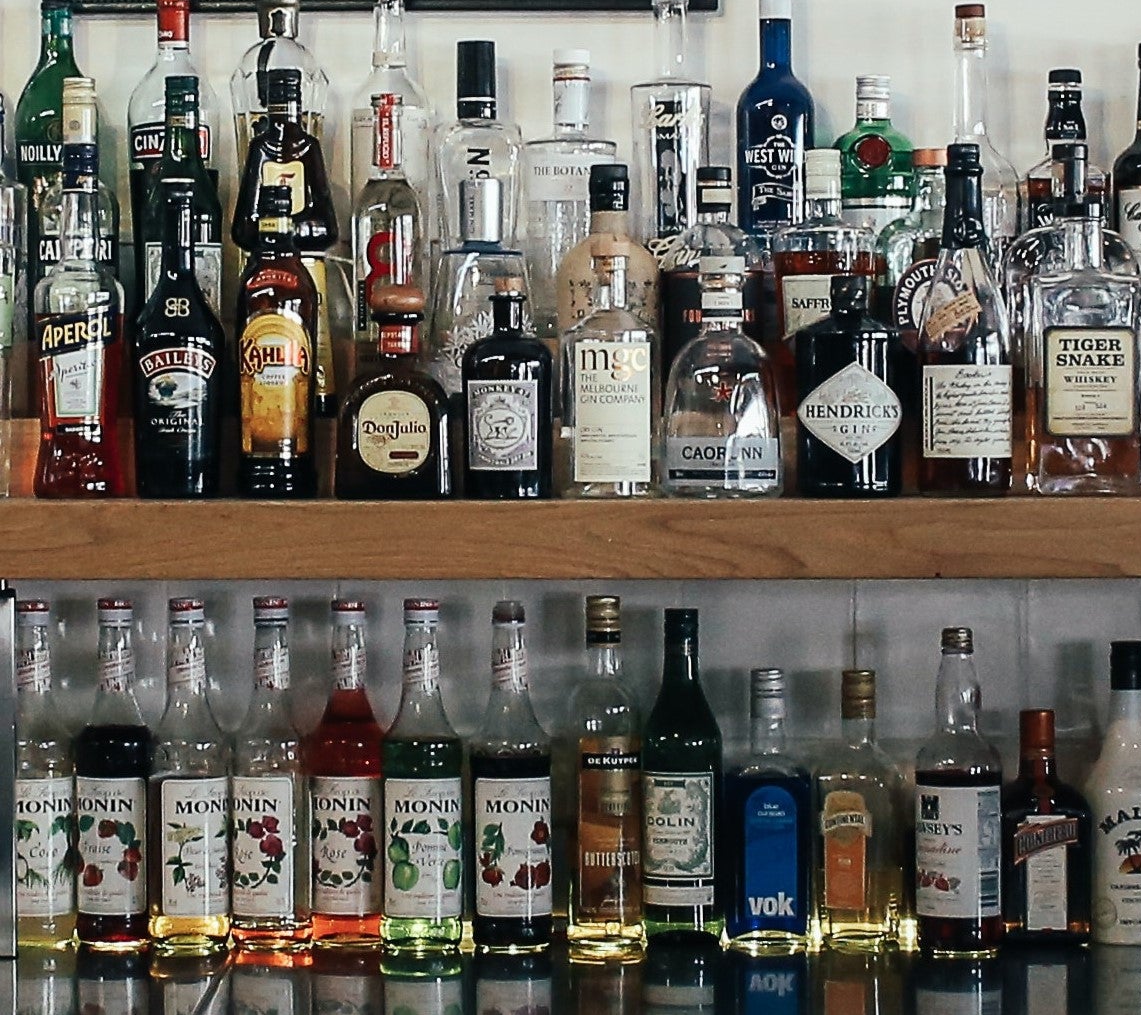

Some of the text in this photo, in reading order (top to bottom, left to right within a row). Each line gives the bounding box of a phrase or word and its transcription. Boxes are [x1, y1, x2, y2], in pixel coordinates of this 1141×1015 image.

[20, 145, 62, 162] NOILLY
[744, 149, 773, 164] WEST
[534, 165, 591, 176] THE BOTAN
[791, 297, 831, 309] SAFFR
[41, 316, 112, 351] APEROL
[1058, 338, 1122, 352] TIGER
[142, 349, 213, 372] BAILEYS
[238, 337, 309, 376] KAHLA
[1056, 354, 1125, 367] SNAKE
[580, 373, 598, 382] THE
[1063, 375, 1118, 384] WHISKEY
[580, 385, 638, 394] MELBOURNE
[580, 395, 646, 404] GIN COMPANY
[805, 405, 899, 420] HENDRICK'S
[681, 445, 763, 461] CAORNN
[394, 799, 460, 814] MONIN
[485, 799, 550, 814] MONIN
[647, 816, 696, 827] DOLIN
[748, 891, 796, 917] vok
